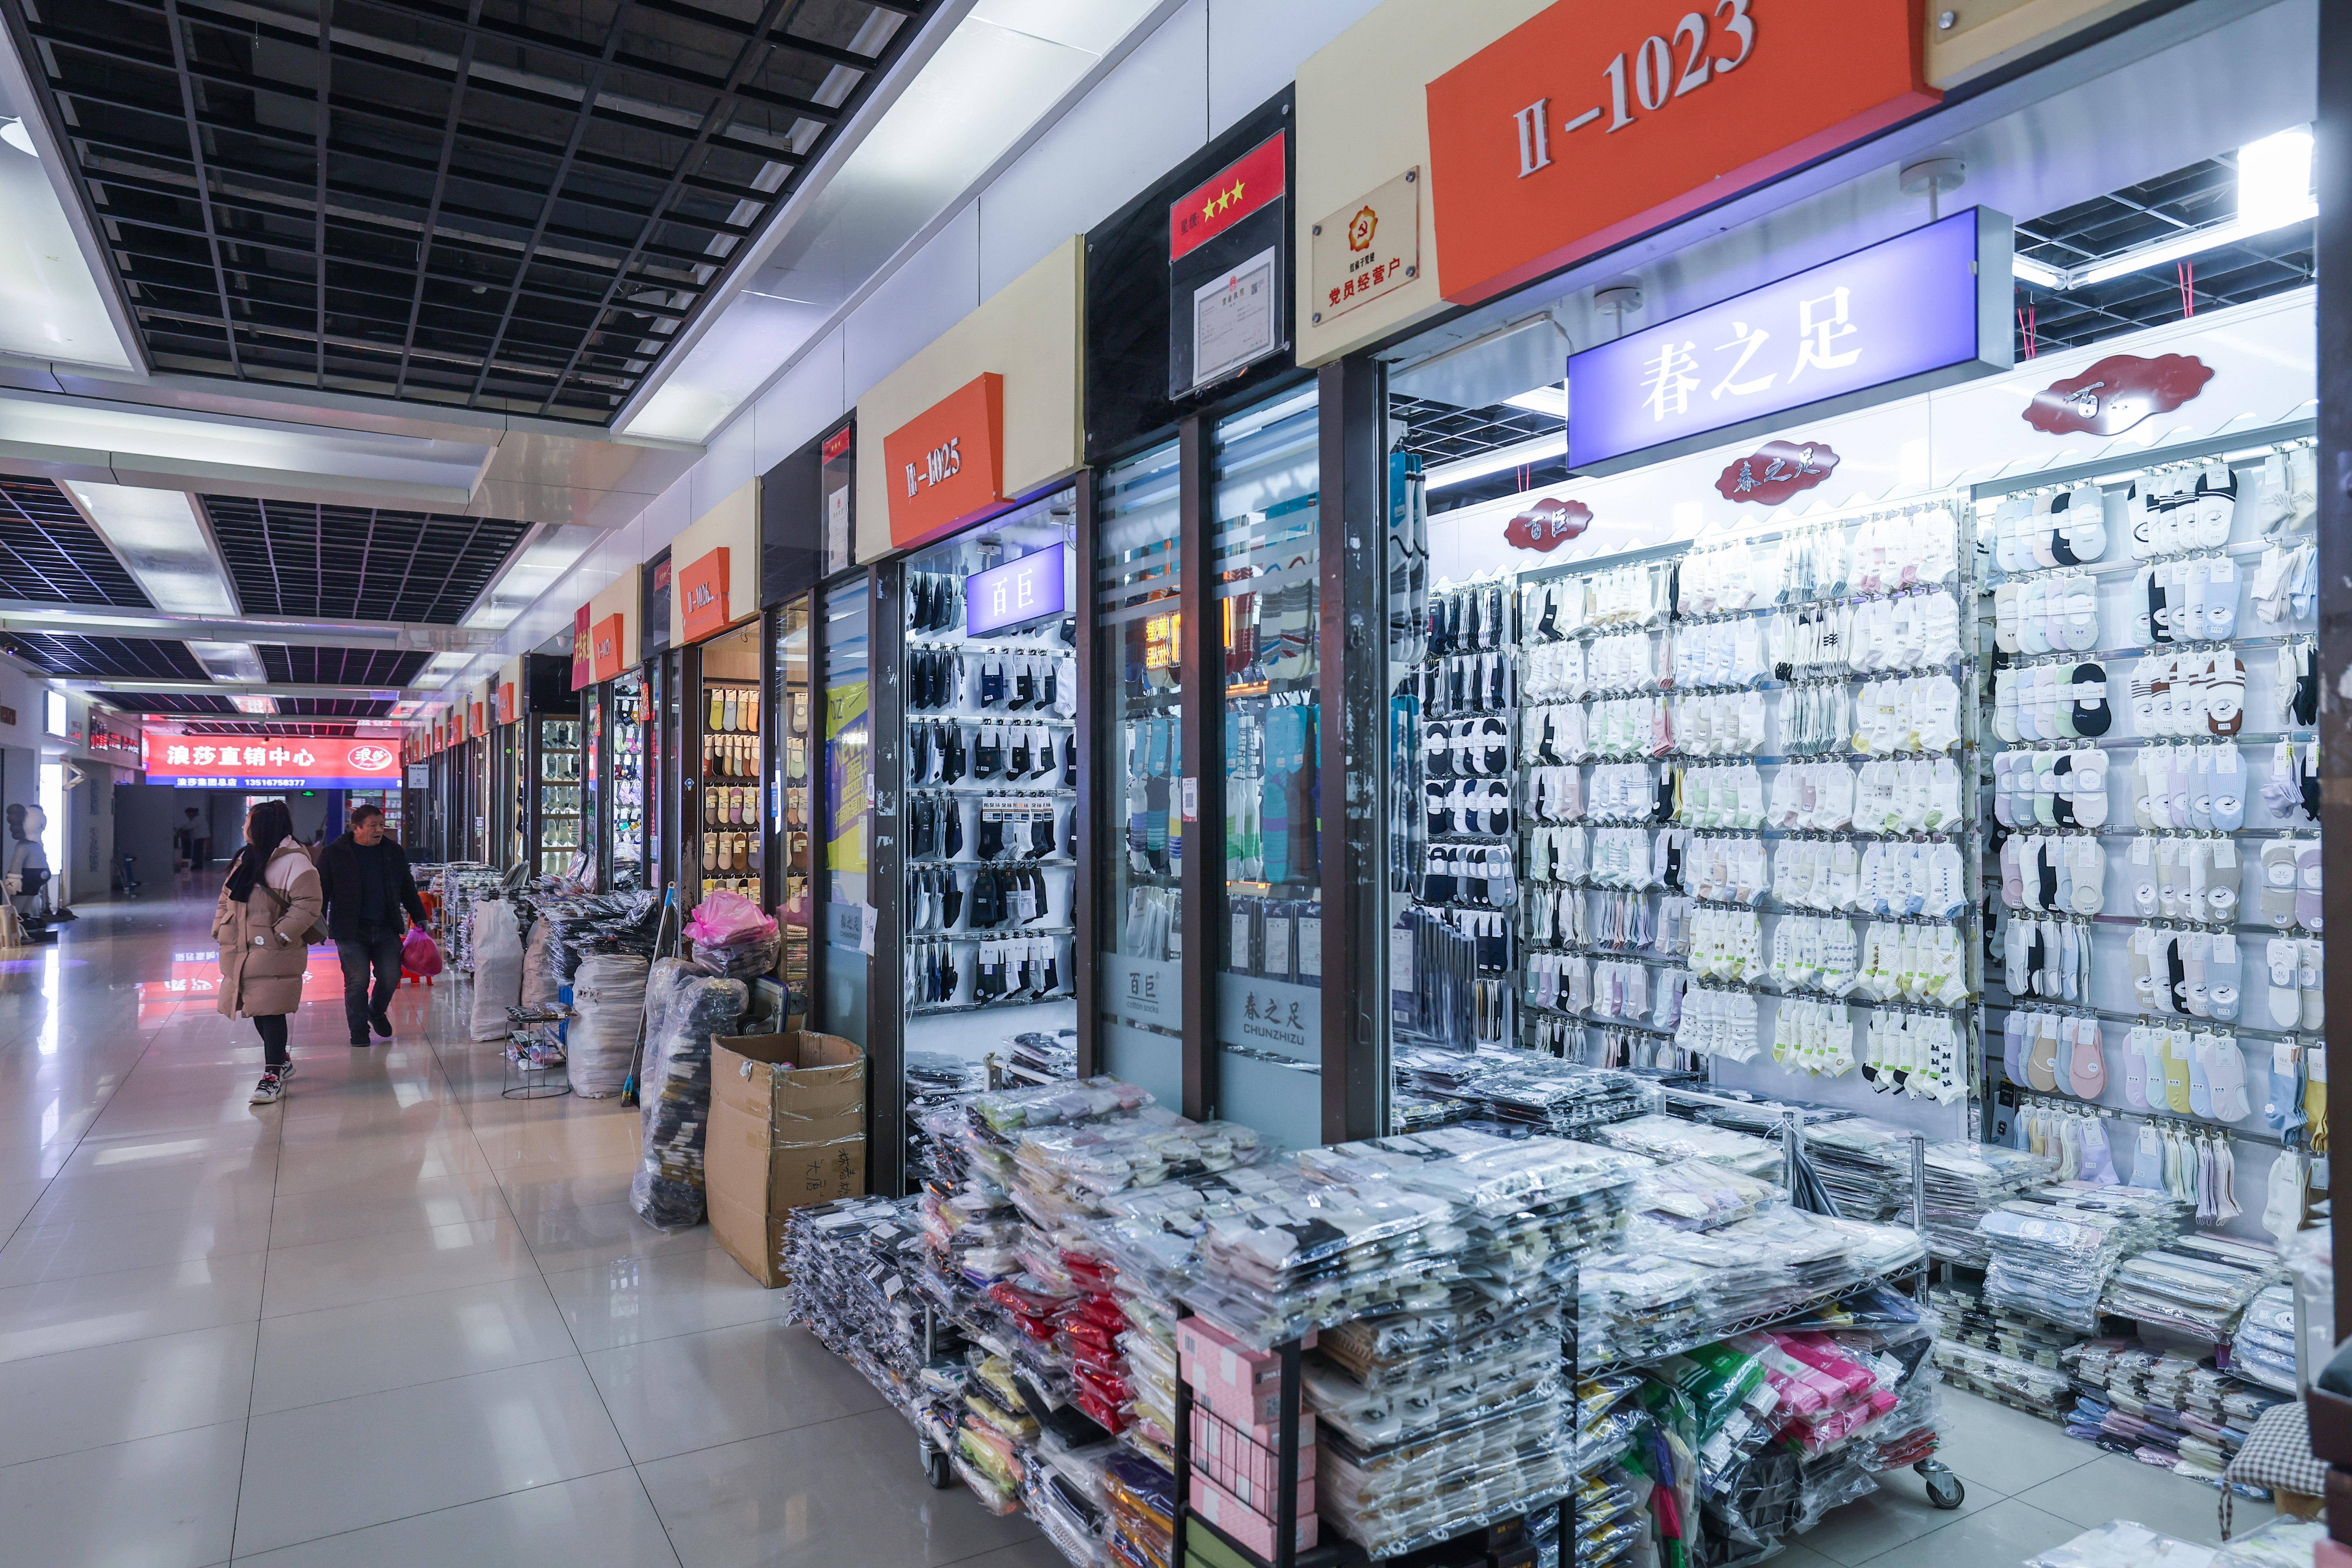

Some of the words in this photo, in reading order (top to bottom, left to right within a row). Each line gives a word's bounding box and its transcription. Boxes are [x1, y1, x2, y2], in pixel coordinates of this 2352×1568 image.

[1328, 257, 1401, 308] 党员经营户
[1639, 286, 1863, 423] 春之足
[1734, 447, 1821, 494] 春之足
[991, 568, 1034, 617] 百巨
[167, 745, 315, 767] 浪莎直销中心
[1129, 972, 1156, 998] 百巨
[1127, 1002, 1142, 1011] cotton
[1143, 1004, 1159, 1014] socks
[1243, 991, 1304, 1030] 春之足
[1243, 1023, 1304, 1046] CHUNZHIZU
